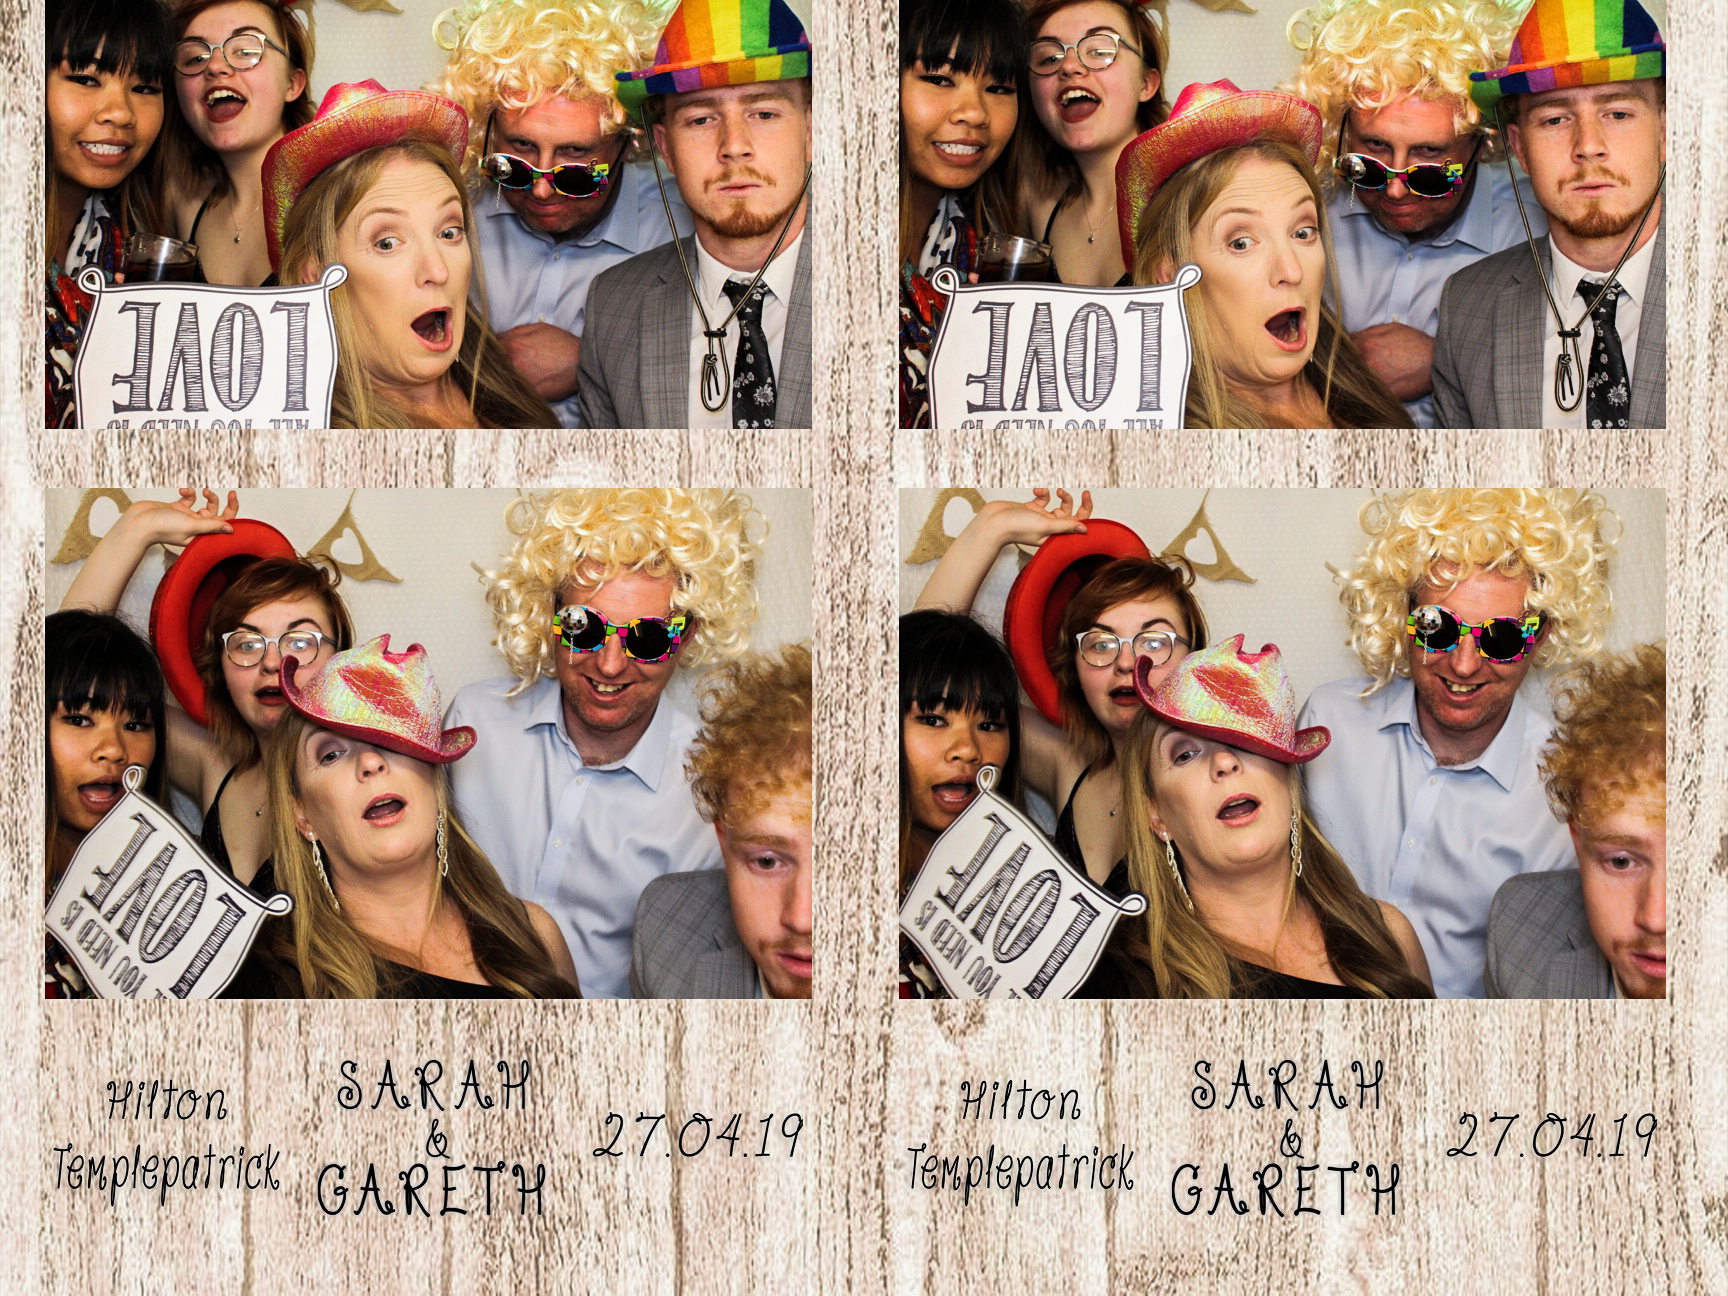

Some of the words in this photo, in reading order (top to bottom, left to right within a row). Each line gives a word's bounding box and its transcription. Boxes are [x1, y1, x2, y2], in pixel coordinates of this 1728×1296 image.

[112, 300, 310, 414] LOVE
[966, 300, 1164, 414] LOVE
[60, 900, 85, 931] IS
[80, 811, 247, 998] LOVE
[914, 900, 939, 931] IS
[934, 811, 1101, 998] LOVE
[76, 918, 119, 970] NEED
[930, 918, 973, 970] NEED
[108, 955, 148, 998] YOU
[962, 955, 1002, 998] YOU
